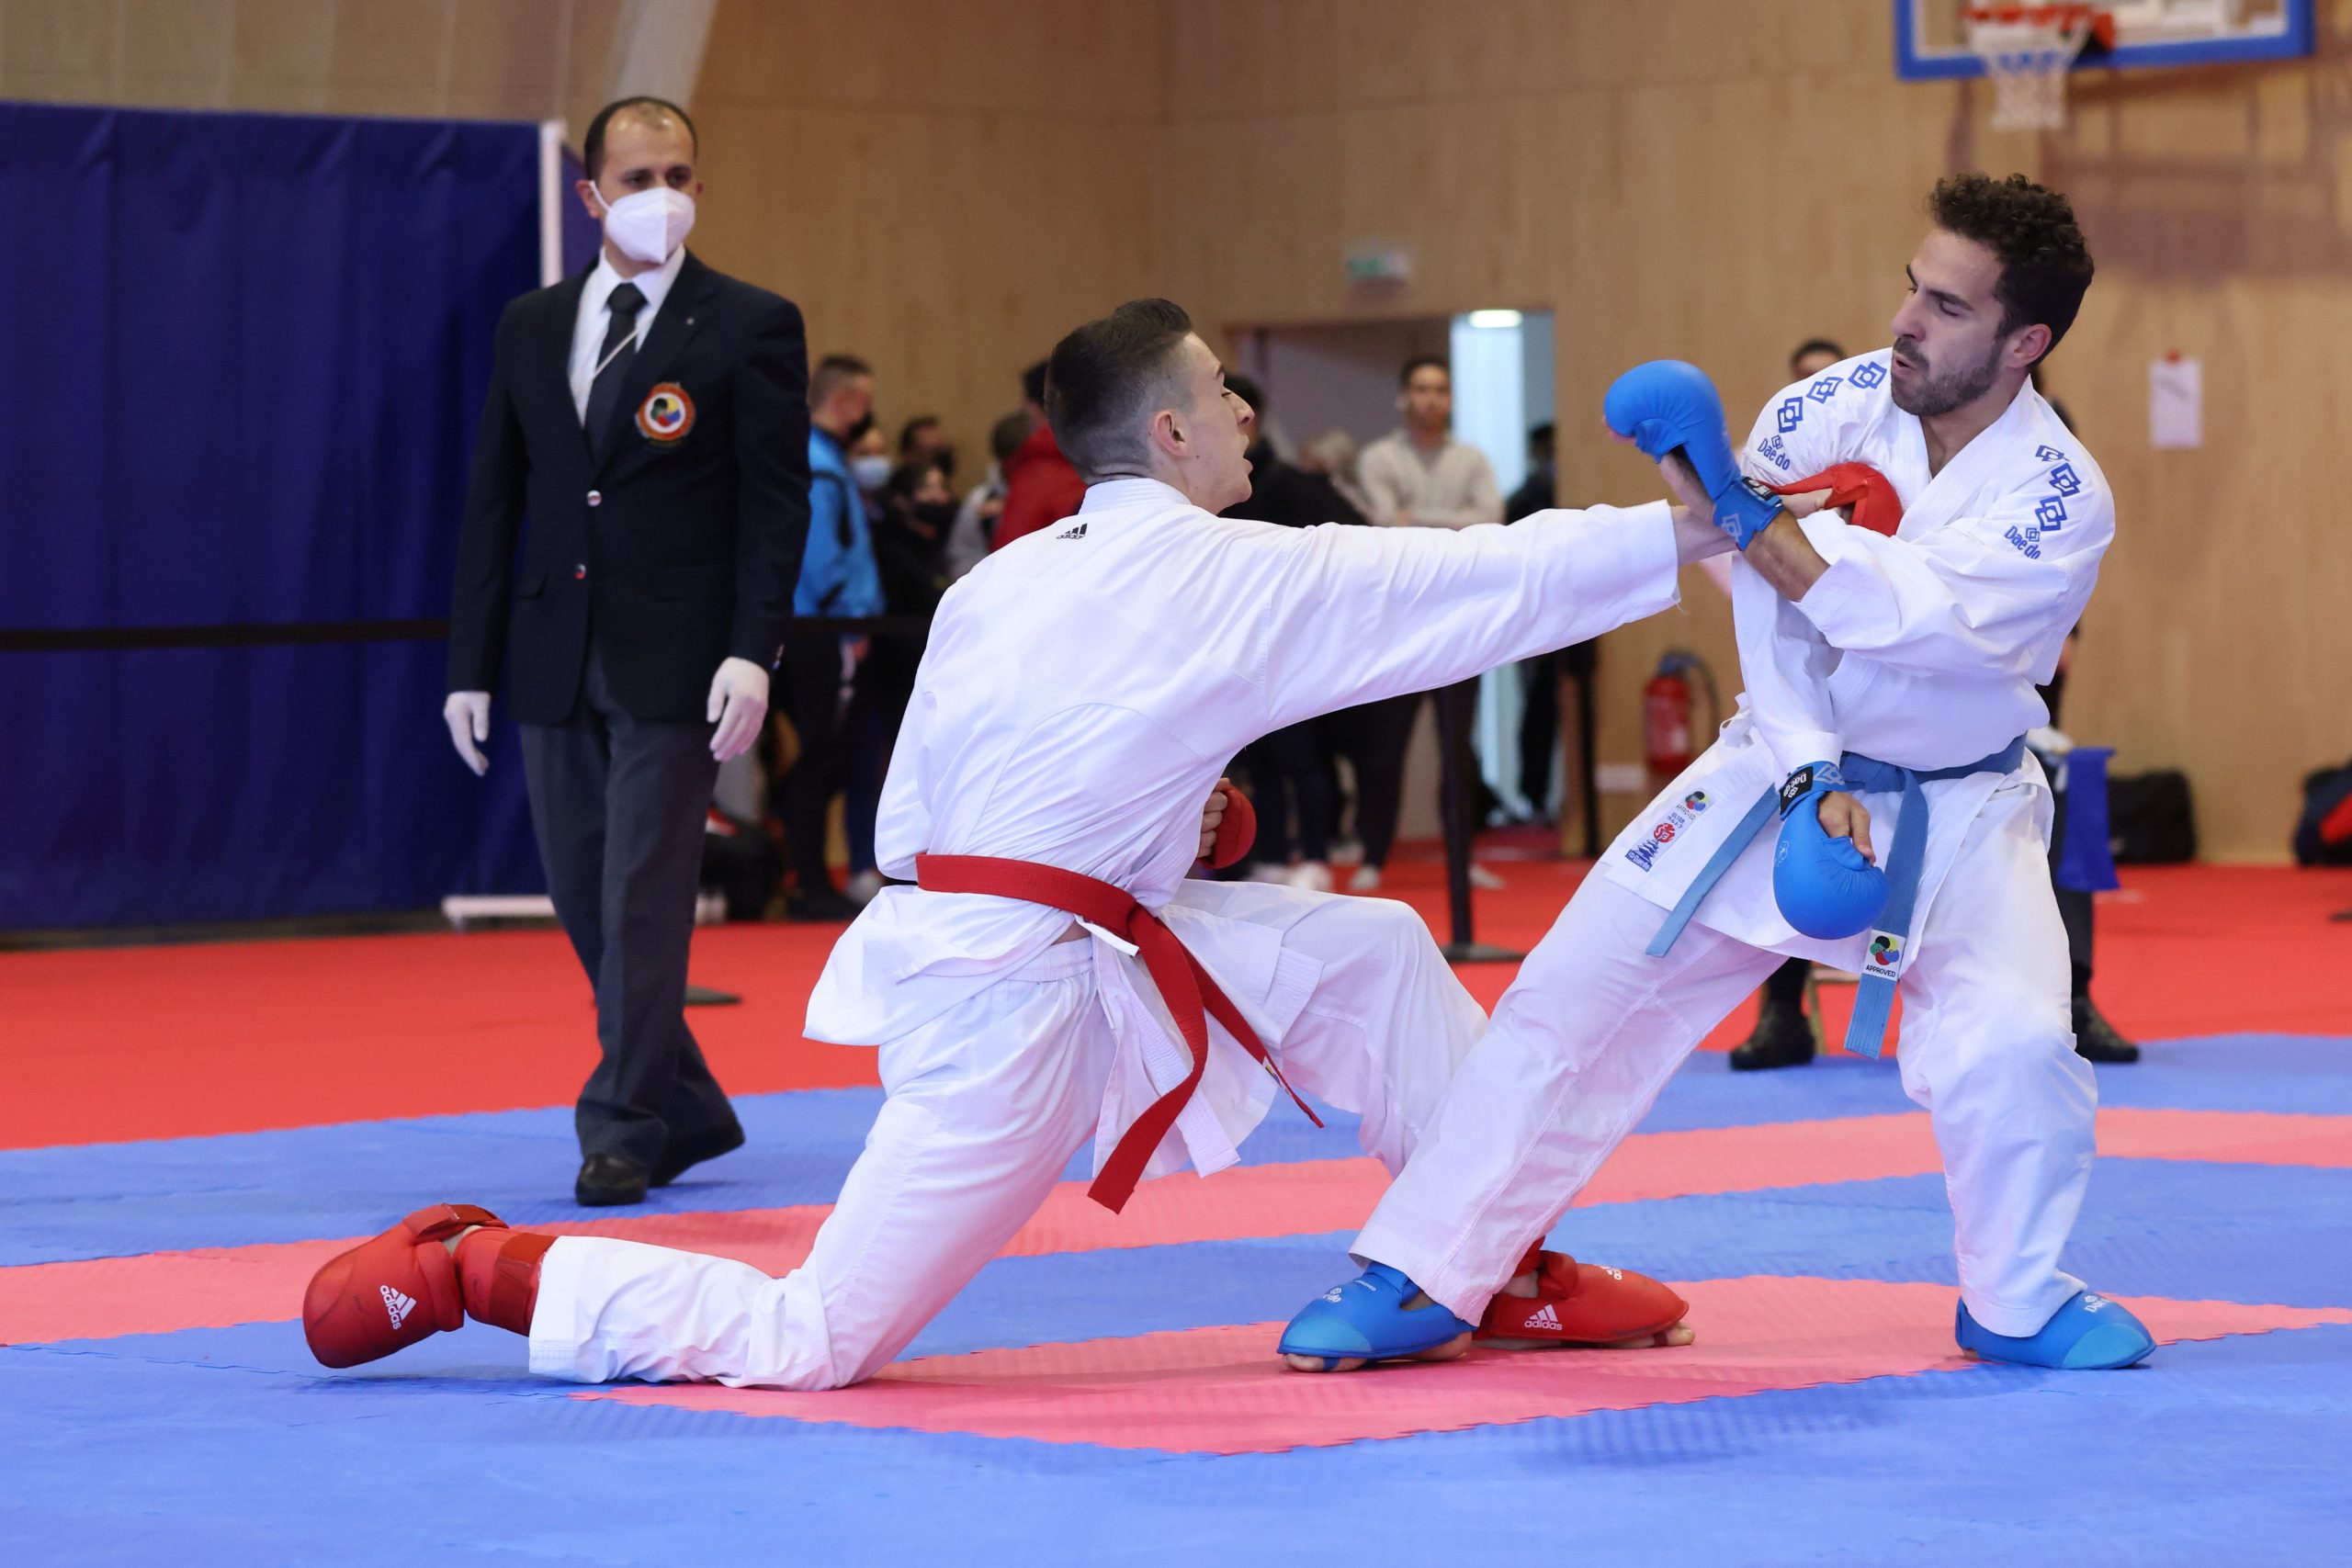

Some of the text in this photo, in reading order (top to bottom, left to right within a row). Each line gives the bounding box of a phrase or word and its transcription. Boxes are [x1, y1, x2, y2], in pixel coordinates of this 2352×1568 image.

[1676, 804, 1697, 820] APPROVED
[1865, 964, 1896, 977] APPROVED
[380, 1285, 401, 1329] adidas
[1524, 1319, 1563, 1331] adidas
